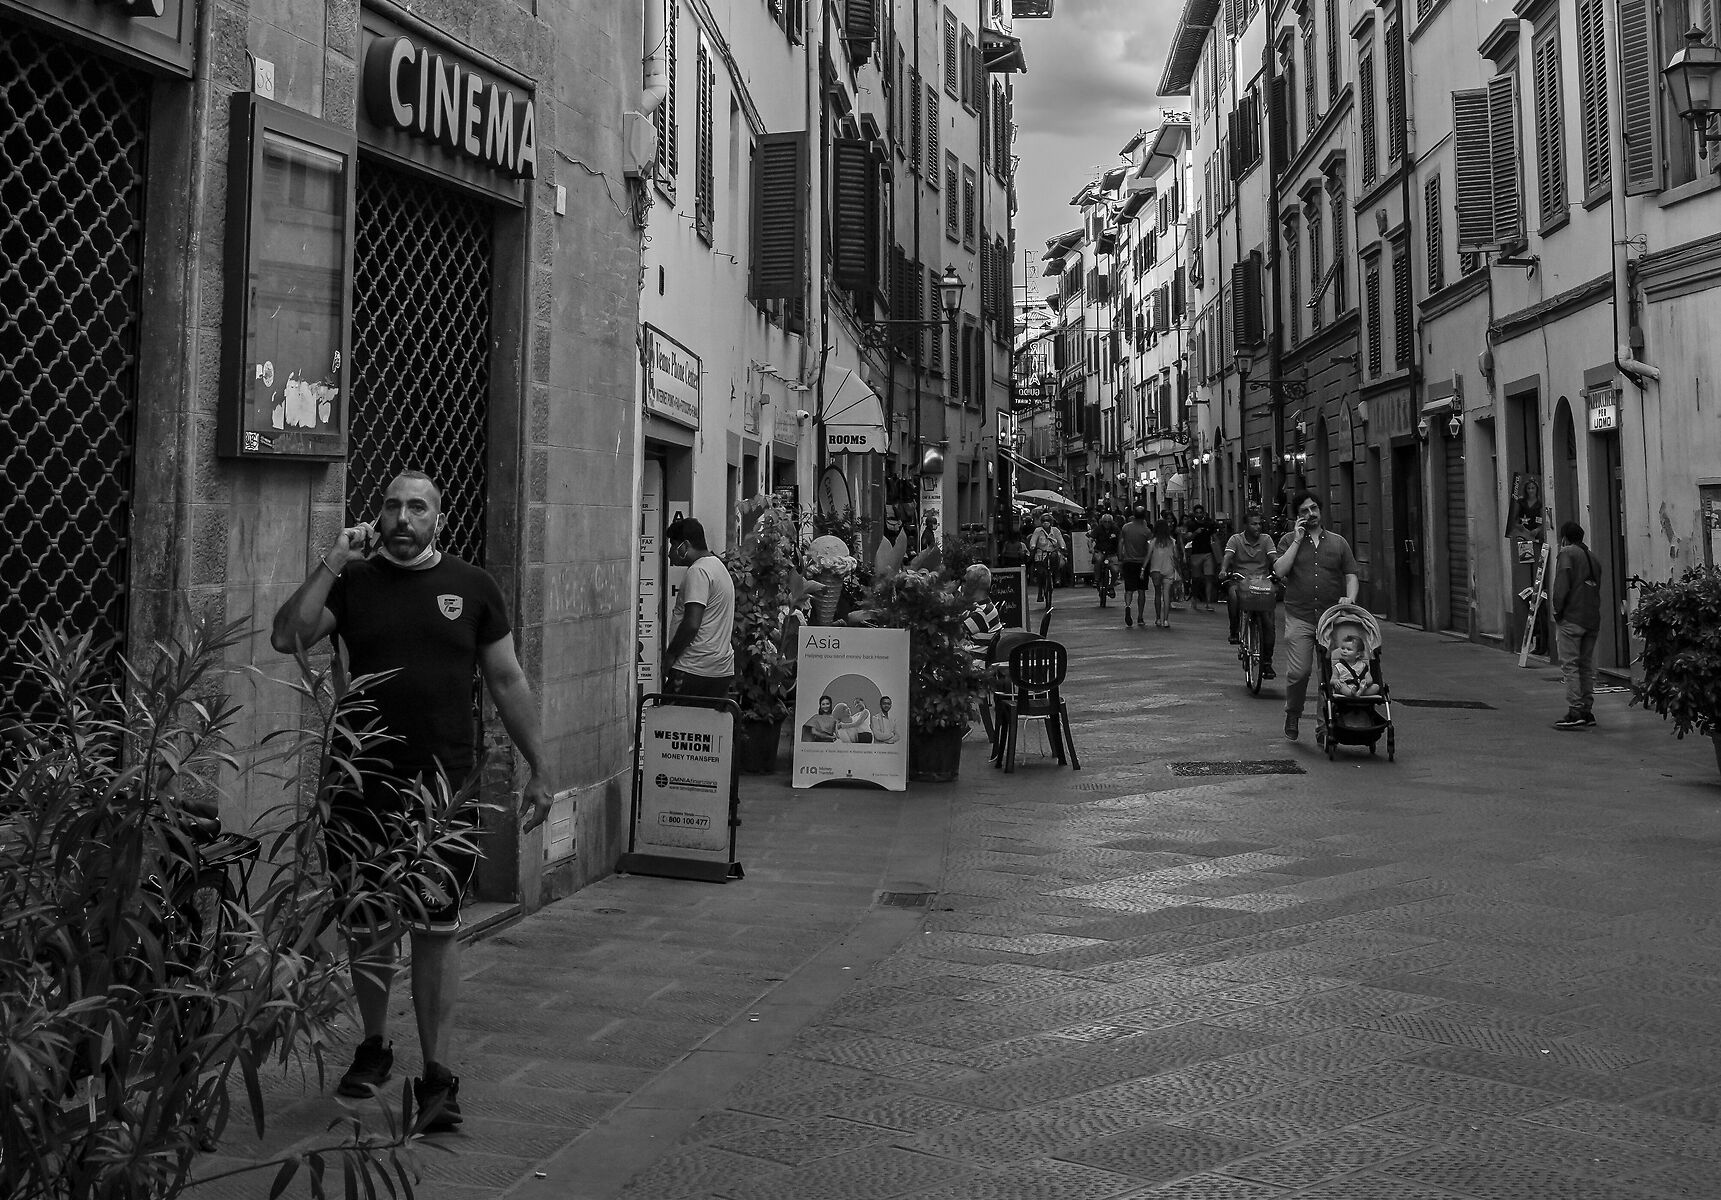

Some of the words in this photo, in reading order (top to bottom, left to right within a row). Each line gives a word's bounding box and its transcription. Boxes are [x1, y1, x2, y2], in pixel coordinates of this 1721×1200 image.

[390, 36, 538, 179] CINEMA
[1594, 417, 1611, 428] UOMO
[828, 435, 867, 445] ROOMS
[805, 634, 841, 650] Asia
[654, 730, 711, 742] WESTERN
[671, 742, 710, 752] UNION
[661, 752, 685, 760] MONEY
[686, 754, 720, 763] TRANSFER
[668, 816, 681, 824] 800
[682, 817, 695, 825] 100
[695, 818, 708, 826] 477
